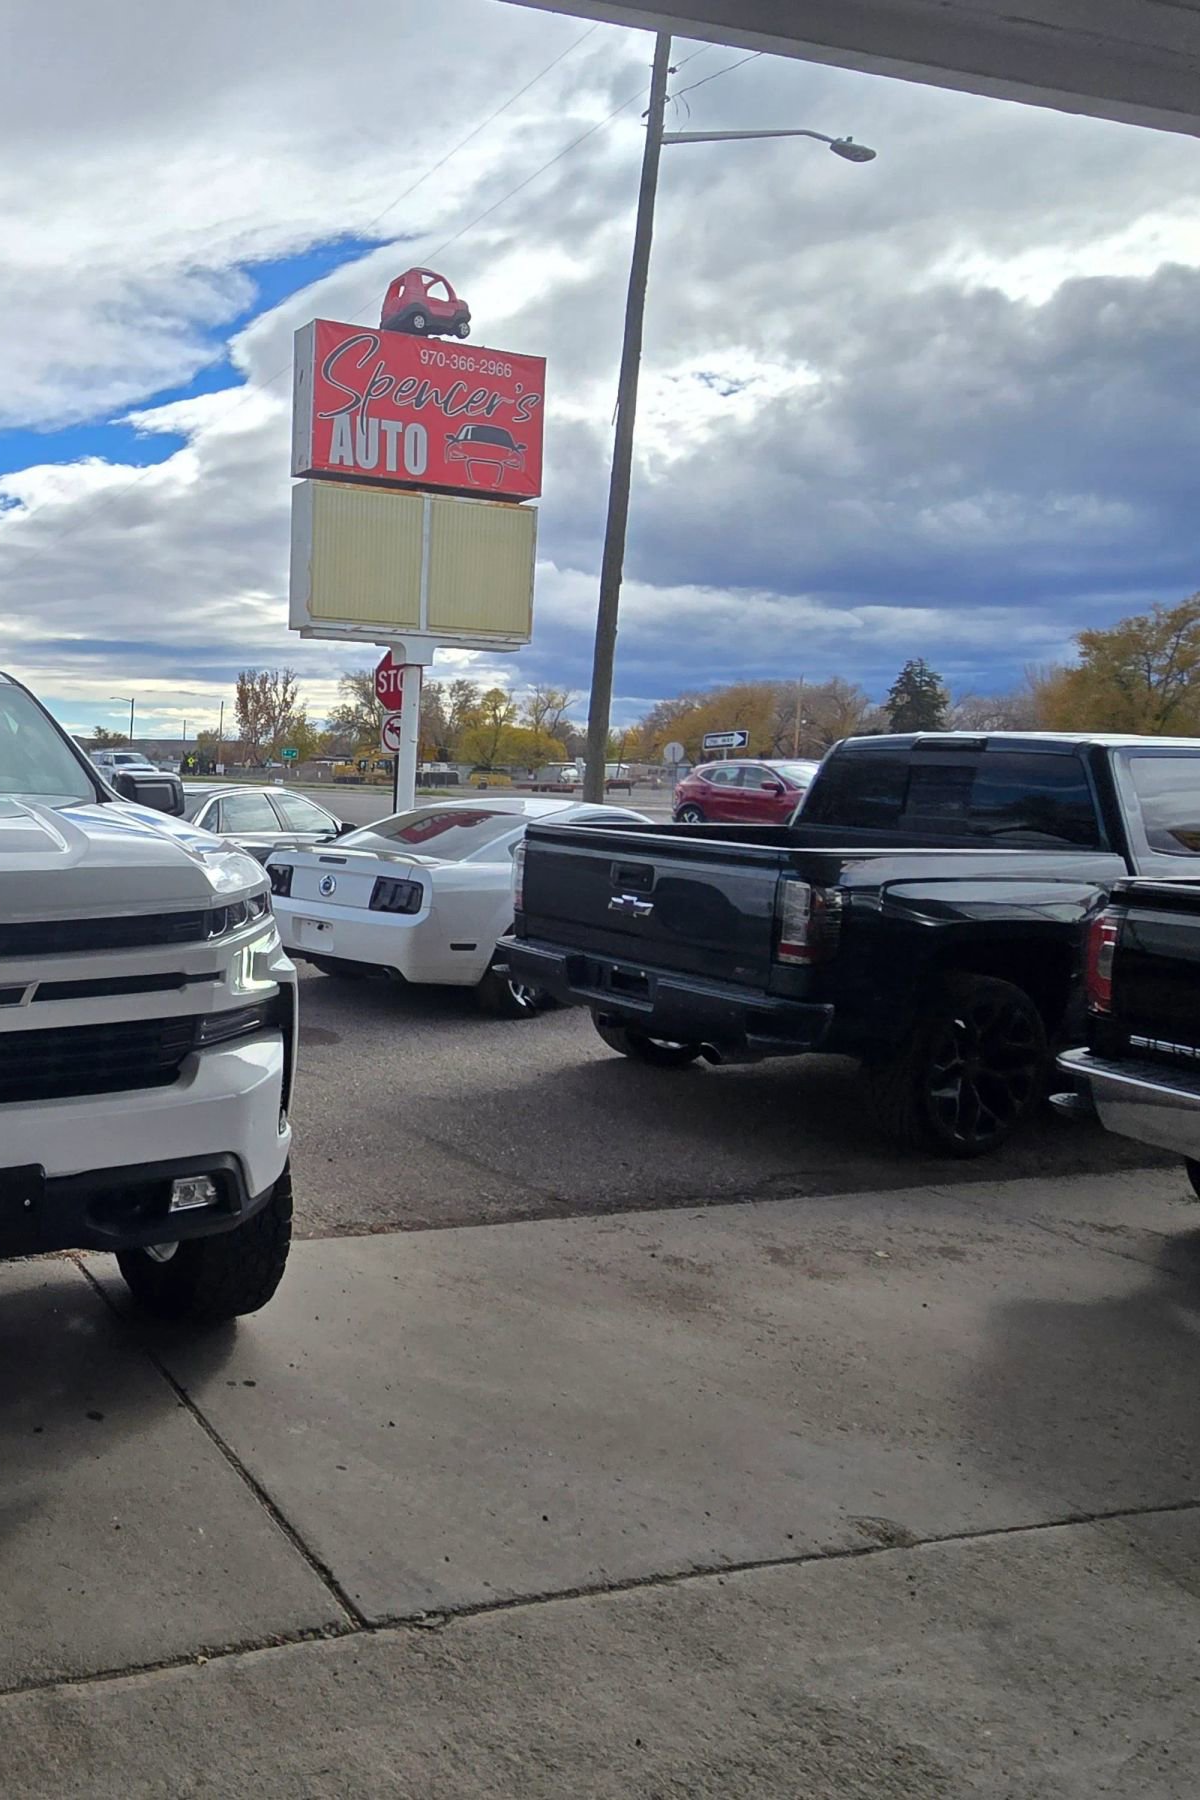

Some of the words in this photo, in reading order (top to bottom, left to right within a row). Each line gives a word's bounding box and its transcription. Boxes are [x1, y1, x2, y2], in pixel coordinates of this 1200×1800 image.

[318, 333, 542, 436] Spencer's
[420, 349, 513, 378] 970-366-2966
[328, 412, 428, 477] AUTO
[377, 668, 404, 694] STO
